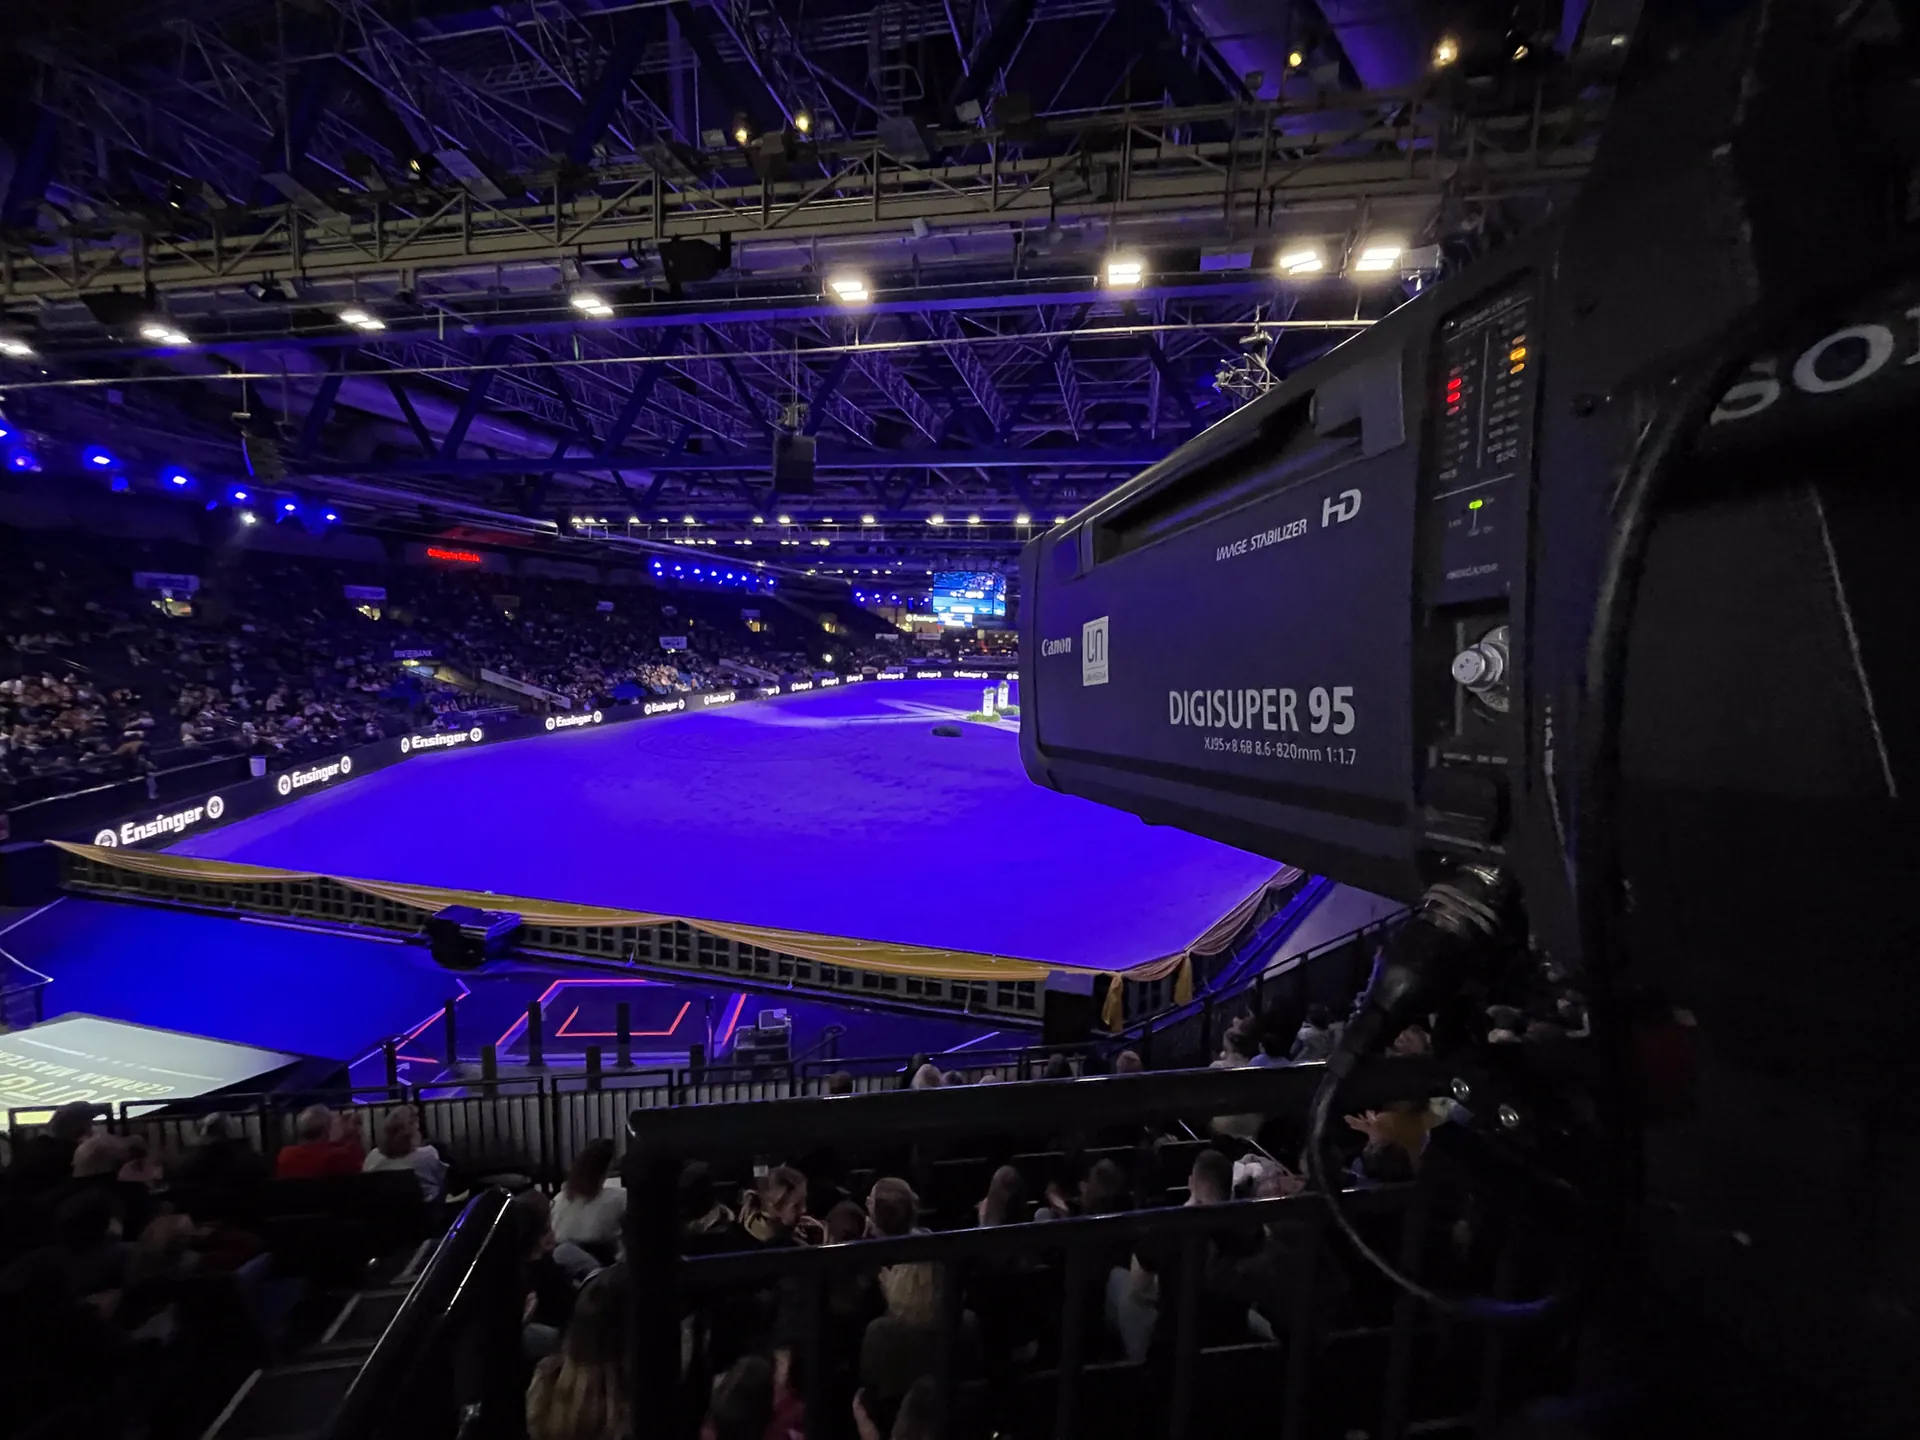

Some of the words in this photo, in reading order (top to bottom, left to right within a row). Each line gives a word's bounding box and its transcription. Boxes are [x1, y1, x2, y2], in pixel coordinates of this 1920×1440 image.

[1710, 306, 1920, 426] SO
[1321, 488, 1362, 528] HD
[1215, 538, 1248, 562] IMAGE
[1250, 518, 1308, 551] STABILIZER
[1041, 637, 1072, 657] Canon
[556, 715, 593, 727] Ensinger
[1168, 687, 1300, 733] DIGISUPER
[1308, 686, 1356, 735] 95
[411, 731, 468, 749] Ensinger
[1326, 746, 1357, 765] 1:1.7
[292, 761, 340, 789] Ensinger
[120, 805, 204, 846] Ensinger
[71, 1072, 176, 1095] GERMAN
